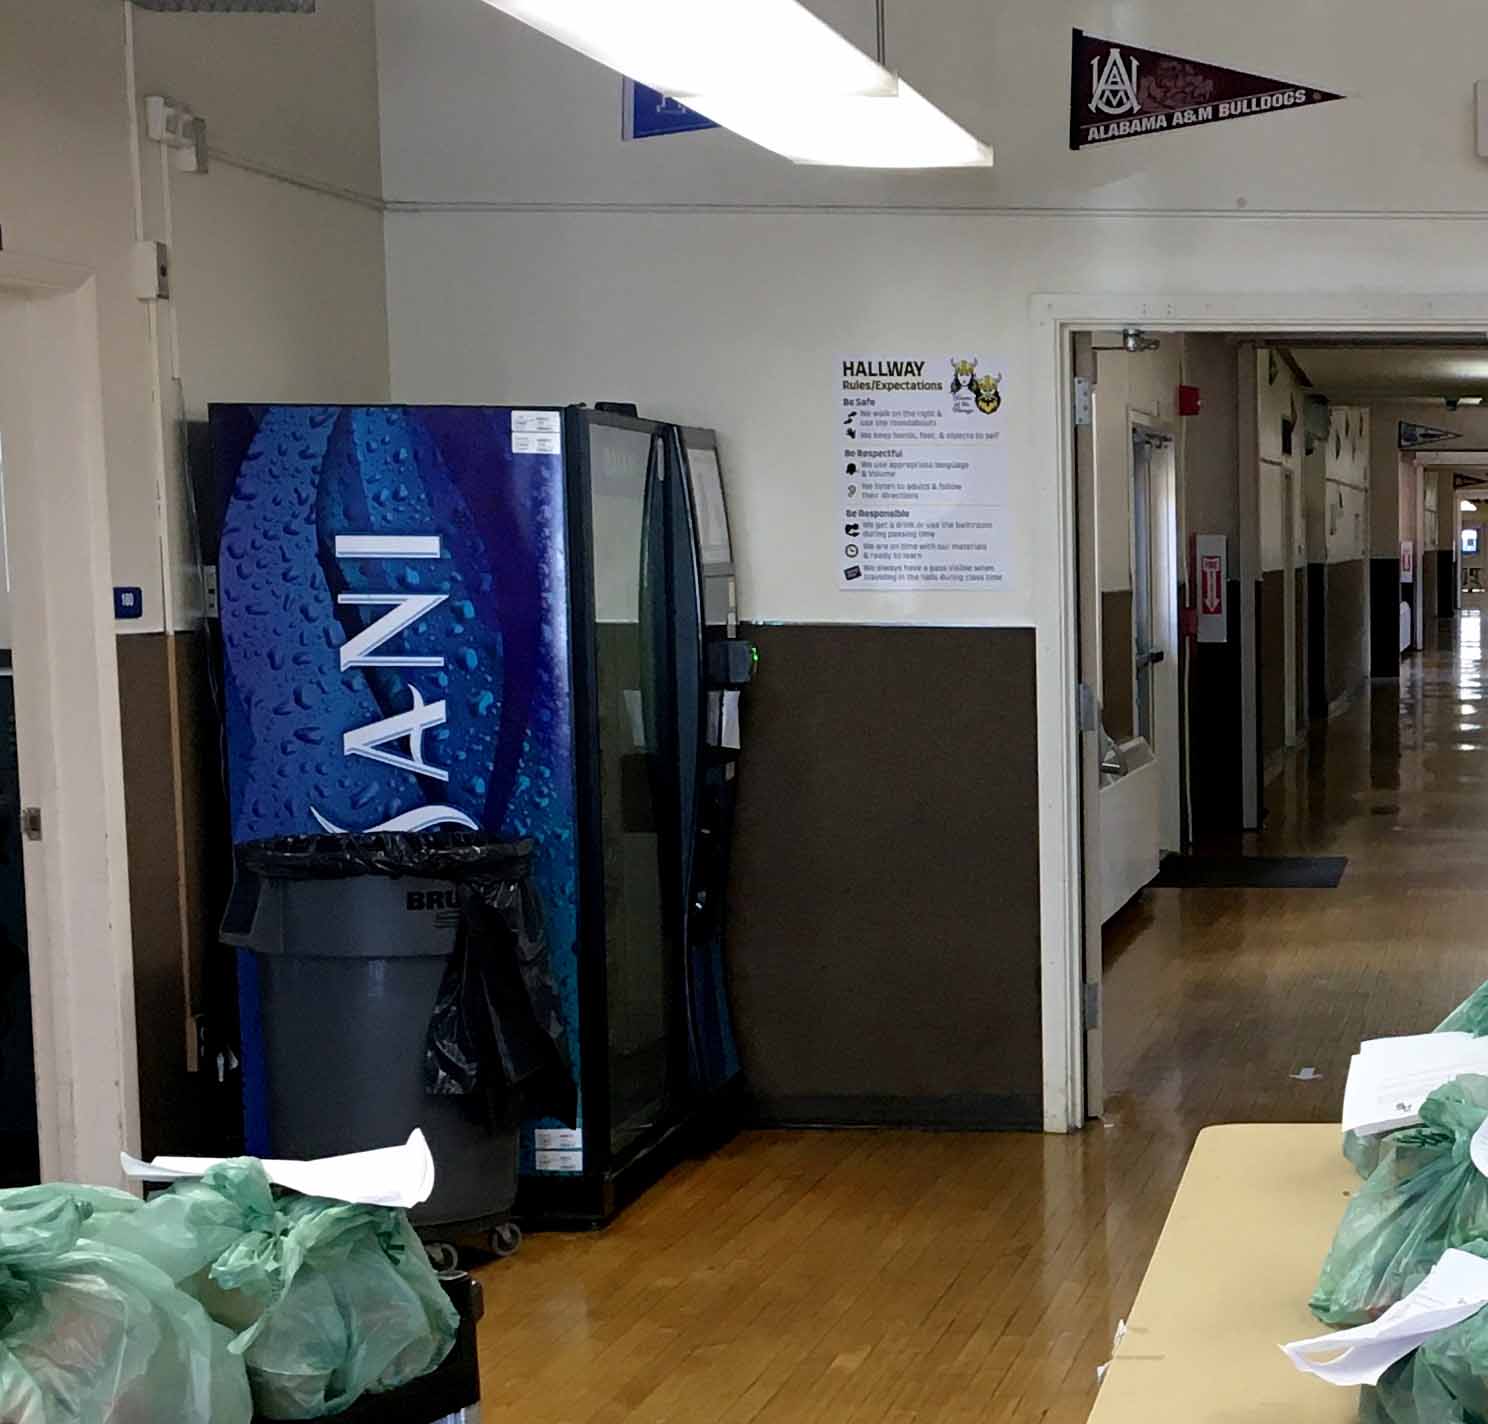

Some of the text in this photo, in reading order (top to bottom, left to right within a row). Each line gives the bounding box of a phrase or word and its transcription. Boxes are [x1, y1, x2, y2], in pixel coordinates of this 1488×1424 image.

[1088, 89, 1306, 141] ALABAMA A&M BULLDOGS
[843, 361, 925, 376] HALLWAY
[843, 380, 943, 391] Rules/Expectations
[843, 398, 875, 406] Be Safe
[918, 410, 935, 418] right
[857, 449, 902, 458] Respectful
[858, 510, 909, 519] Responsible
[406, 890, 462, 910] BRU
